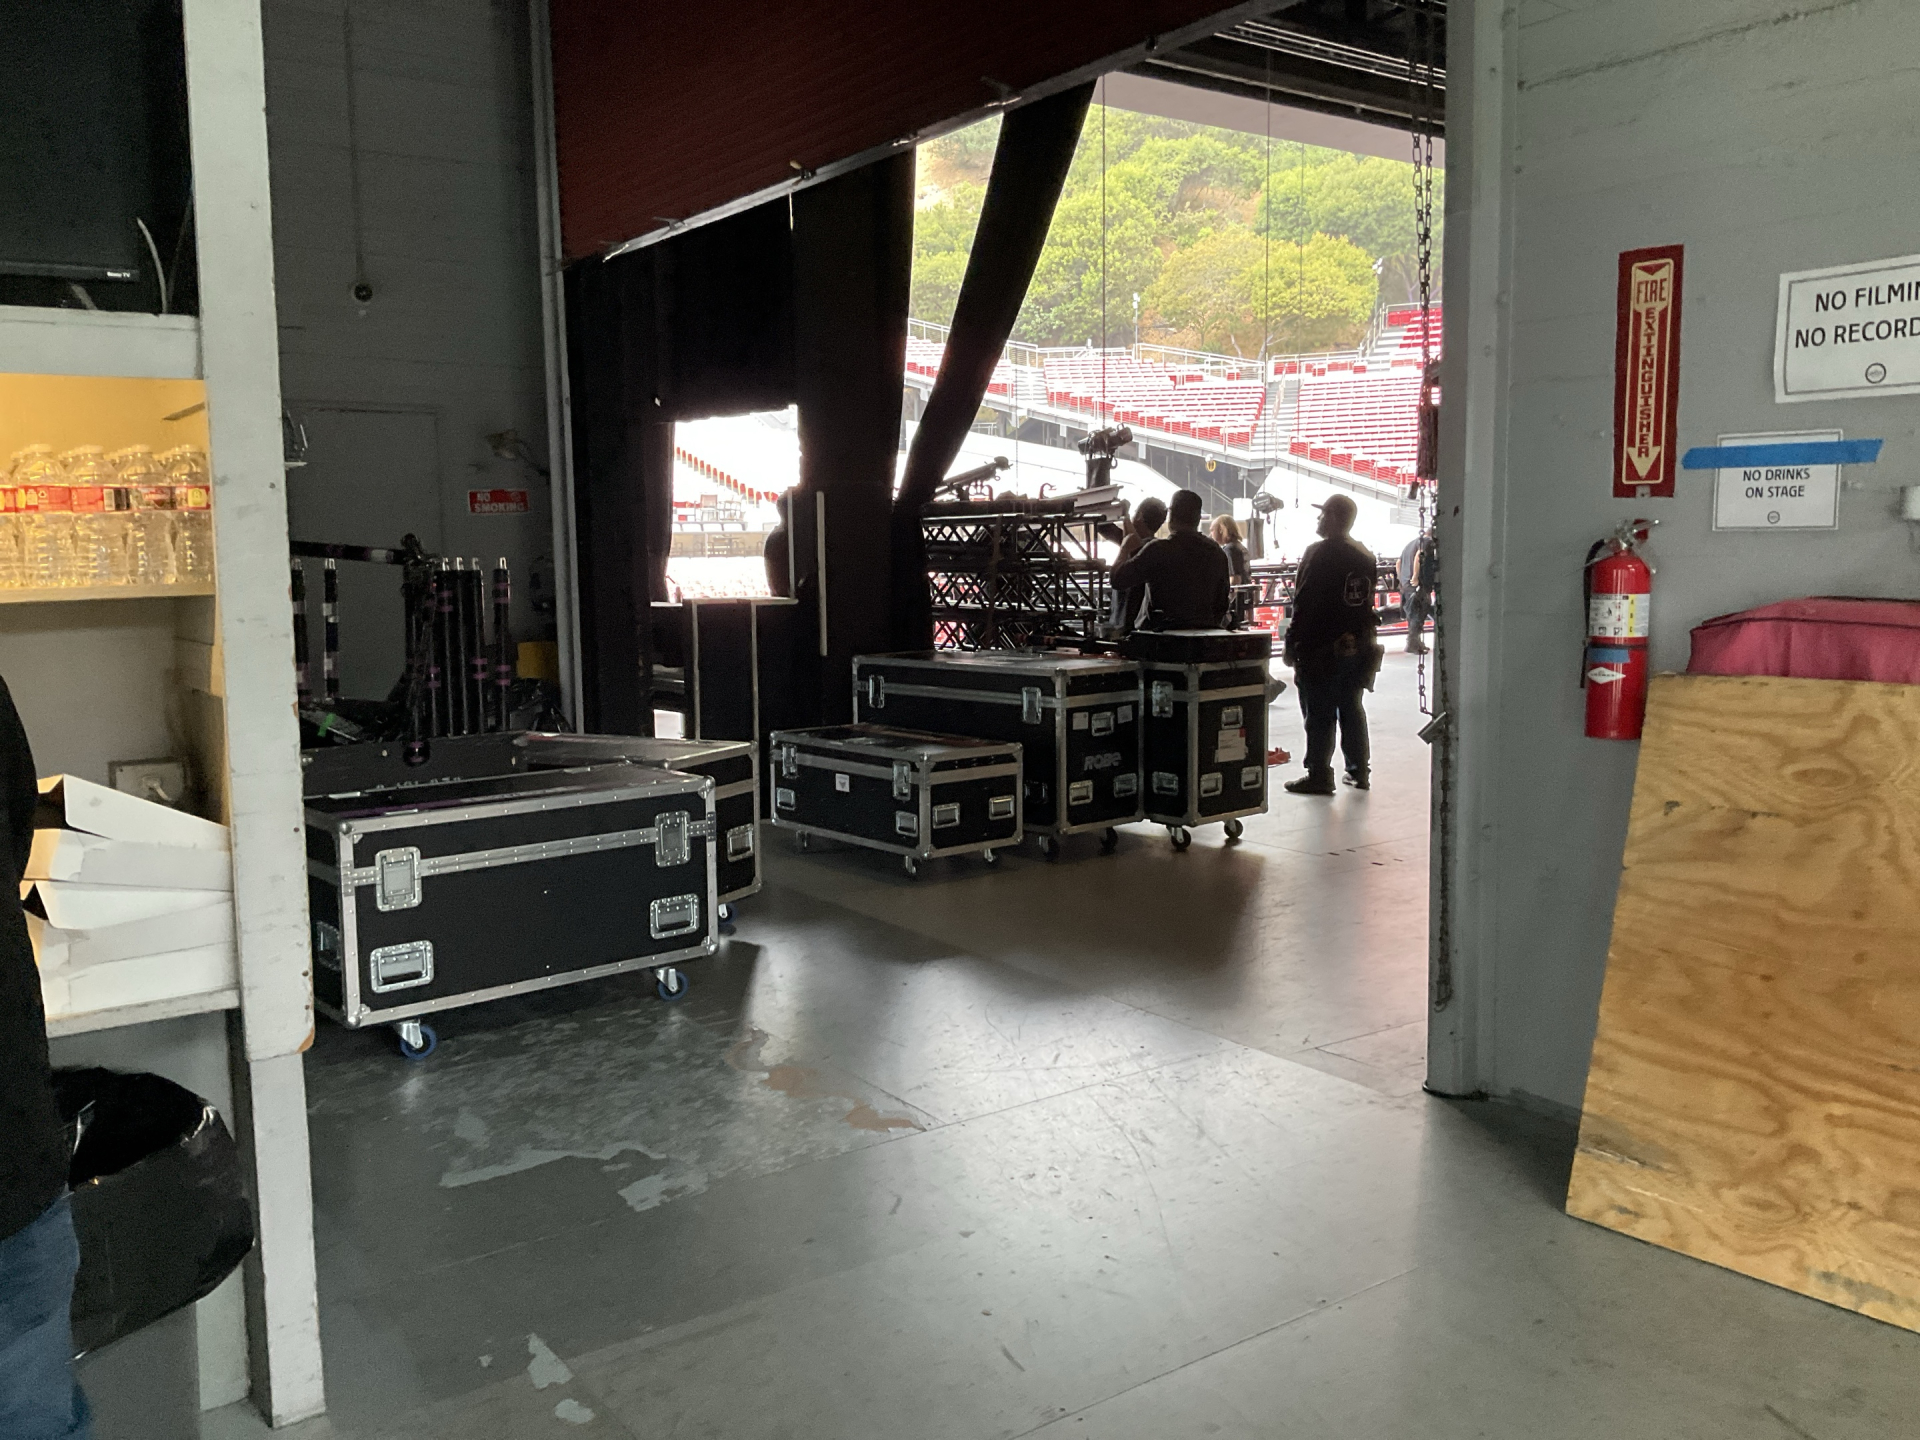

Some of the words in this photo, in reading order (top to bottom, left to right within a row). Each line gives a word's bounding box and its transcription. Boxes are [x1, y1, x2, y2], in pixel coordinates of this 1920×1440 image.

[1636, 278, 1668, 304] FIRE
[1815, 290, 1847, 313] NO
[1795, 327, 1826, 349] NO
[1834, 316, 1920, 345] RECORD
[1637, 307, 1656, 458] EXTINGUISHER
[1743, 469, 1761, 481] NO
[1765, 467, 1810, 481] DRINKS
[477, 492, 491, 502] NO
[1745, 486, 1764, 498] ON
[1767, 485, 1805, 498] STAGE
[475, 502, 525, 513] SMOKING
